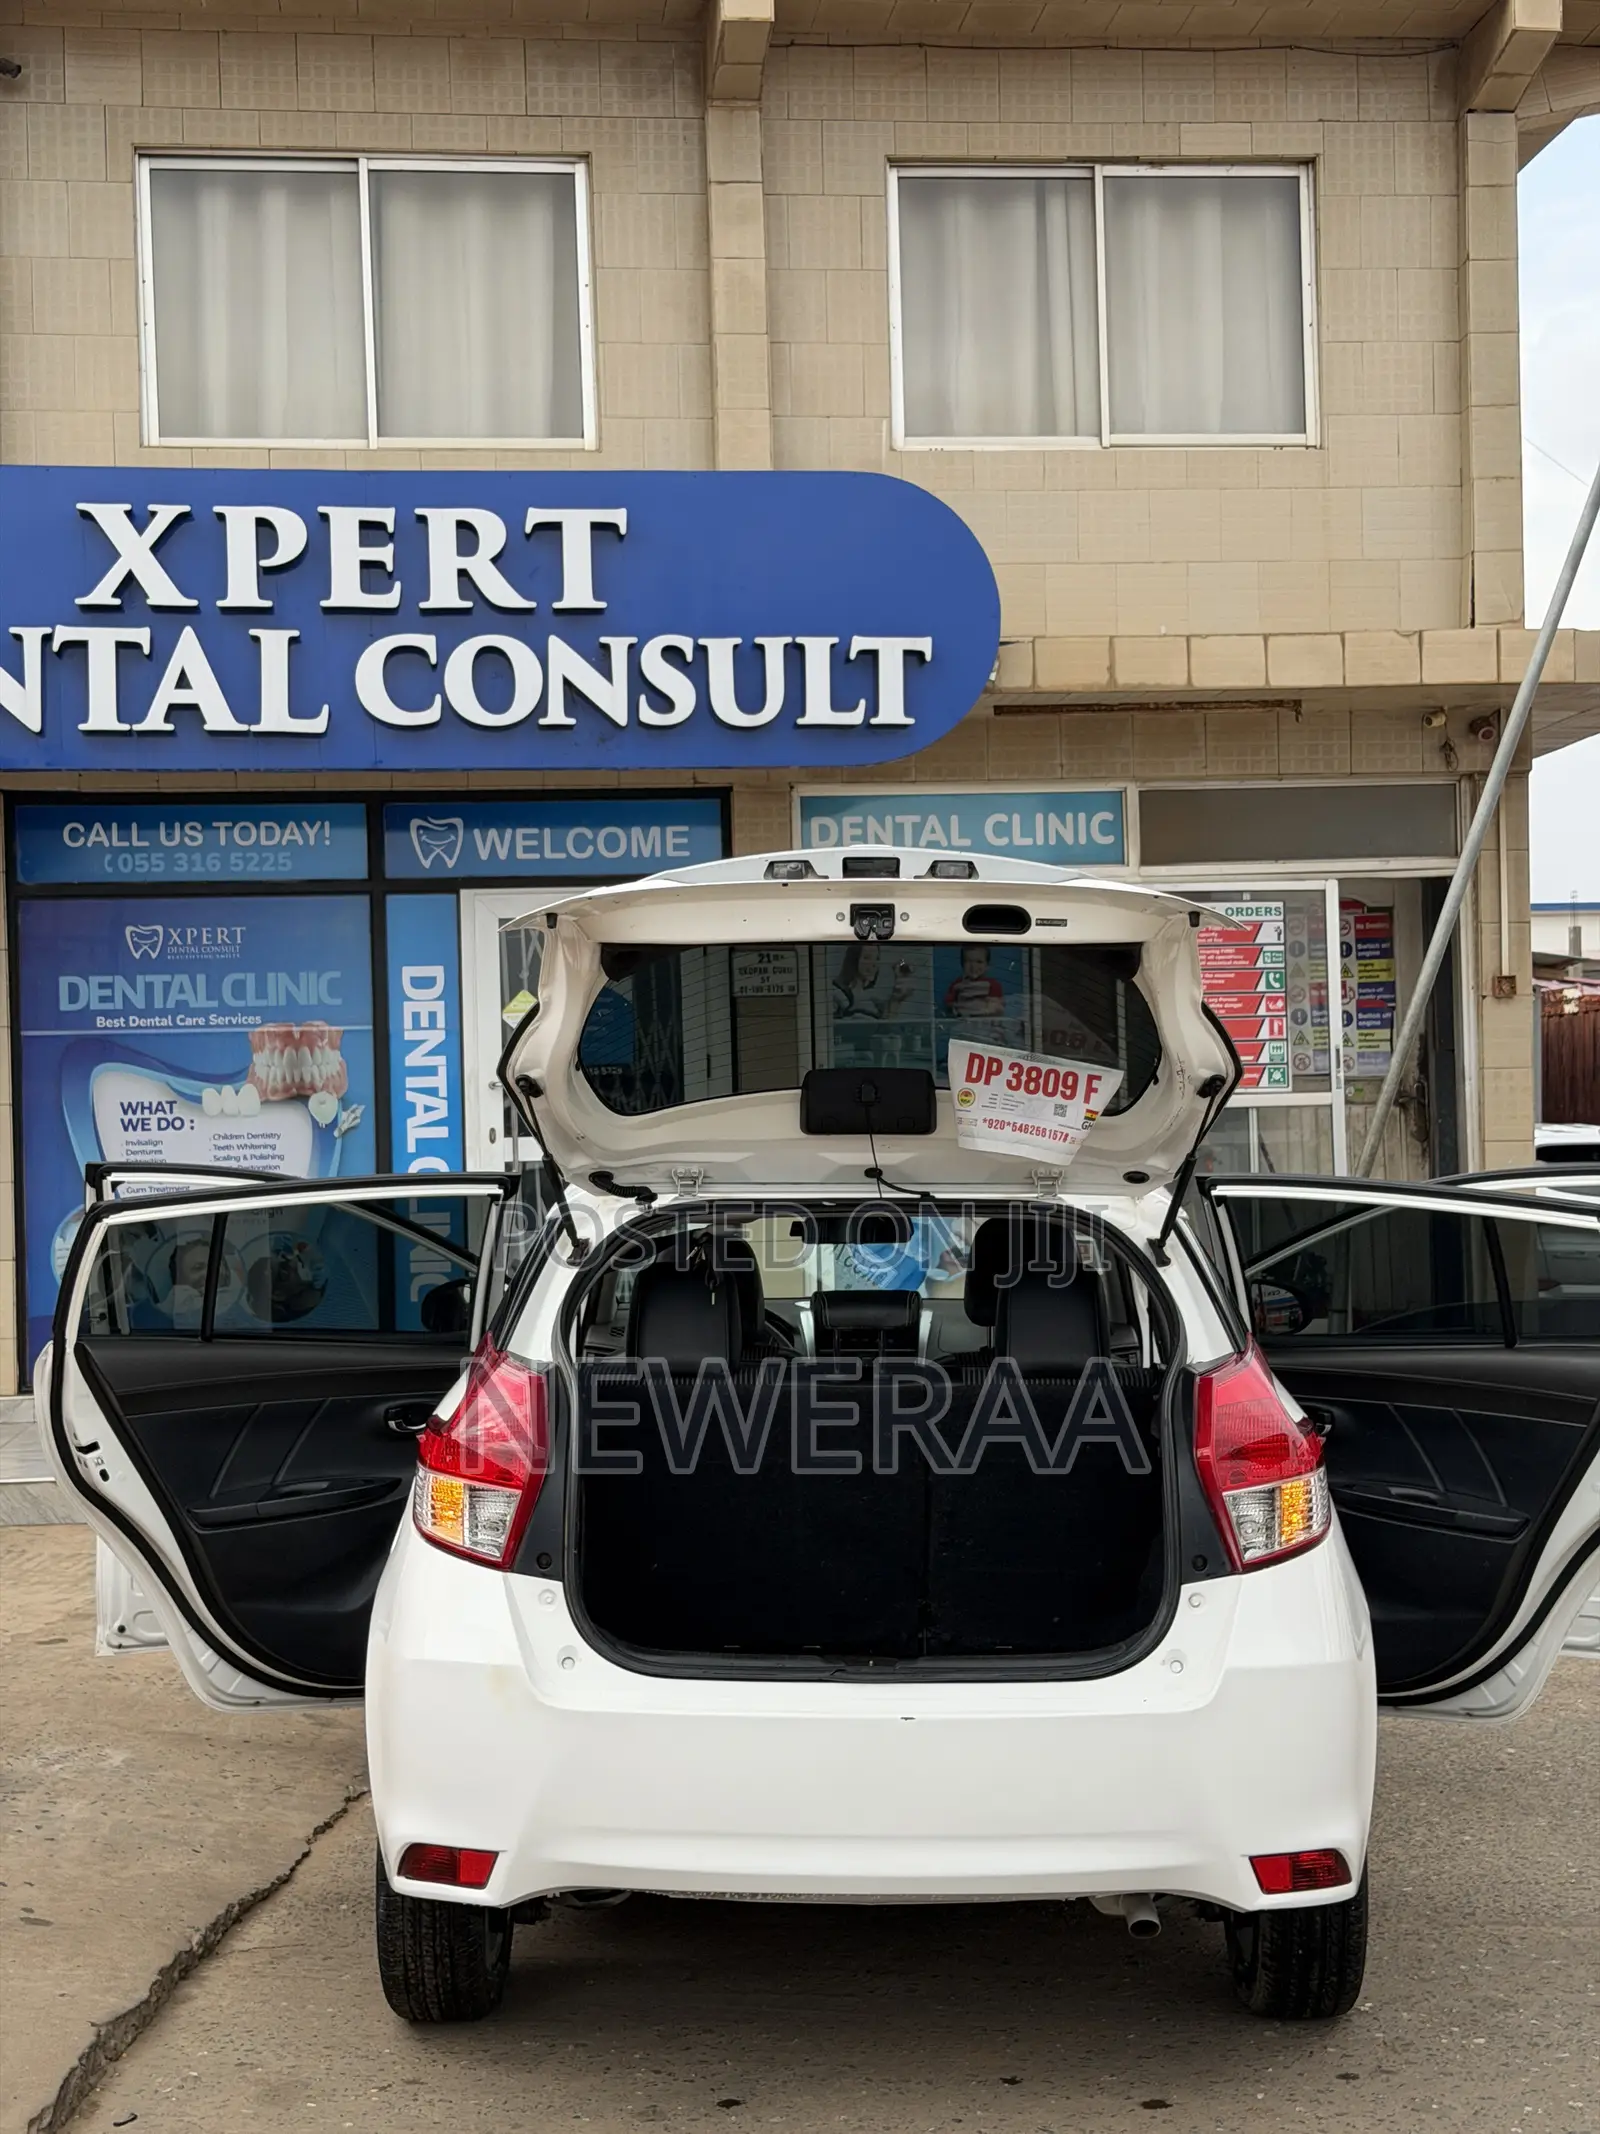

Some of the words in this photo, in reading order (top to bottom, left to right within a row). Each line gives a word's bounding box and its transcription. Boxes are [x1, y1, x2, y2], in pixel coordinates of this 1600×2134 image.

[74, 502, 628, 610] XPERT
[354, 633, 933, 728] CONSULT
[62, 822, 150, 848] CALL
[159, 821, 204, 848] US
[212, 820, 332, 847] TODAY!
[809, 813, 972, 848] DENTAL
[983, 811, 1116, 847] CLINIC
[472, 824, 692, 861] WELCOME
[117, 852, 166, 874] 055
[173, 852, 222, 873] 316
[229, 851, 293, 872] 5225
[1224, 906, 1282, 917] ORDERS
[168, 926, 247, 945] XPERT
[167, 945, 200, 954] DENTAL
[201, 944, 241, 954] CONSULT
[58, 973, 219, 1012] DENTAL
[221, 970, 343, 1008] CLINIC
[96, 1016, 127, 1028] Best
[129, 1014, 174, 1027] Dental
[176, 1014, 207, 1026] Care
[208, 1012, 263, 1025] Services
[401, 964, 449, 1154] DENTAL
[964, 1051, 1004, 1086] DP
[1005, 1061, 1080, 1101] 3809
[1083, 1073, 1103, 1105] F
[120, 1100, 178, 1116] WHAT
[120, 1117, 152, 1132] WE
[157, 1117, 185, 1131] DO
[125, 1139, 164, 1148] Invisalign
[212, 1133, 245, 1141] Children
[246, 1132, 281, 1141] Dentistry
[212, 1143, 235, 1152] Teeth
[236, 1143, 277, 1152] Whitening
[213, 1154, 241, 1163] Scaling
[250, 1153, 285, 1162] Polishing
[126, 1186, 147, 1194] Gum
[148, 1185, 191, 1193] Treatment
